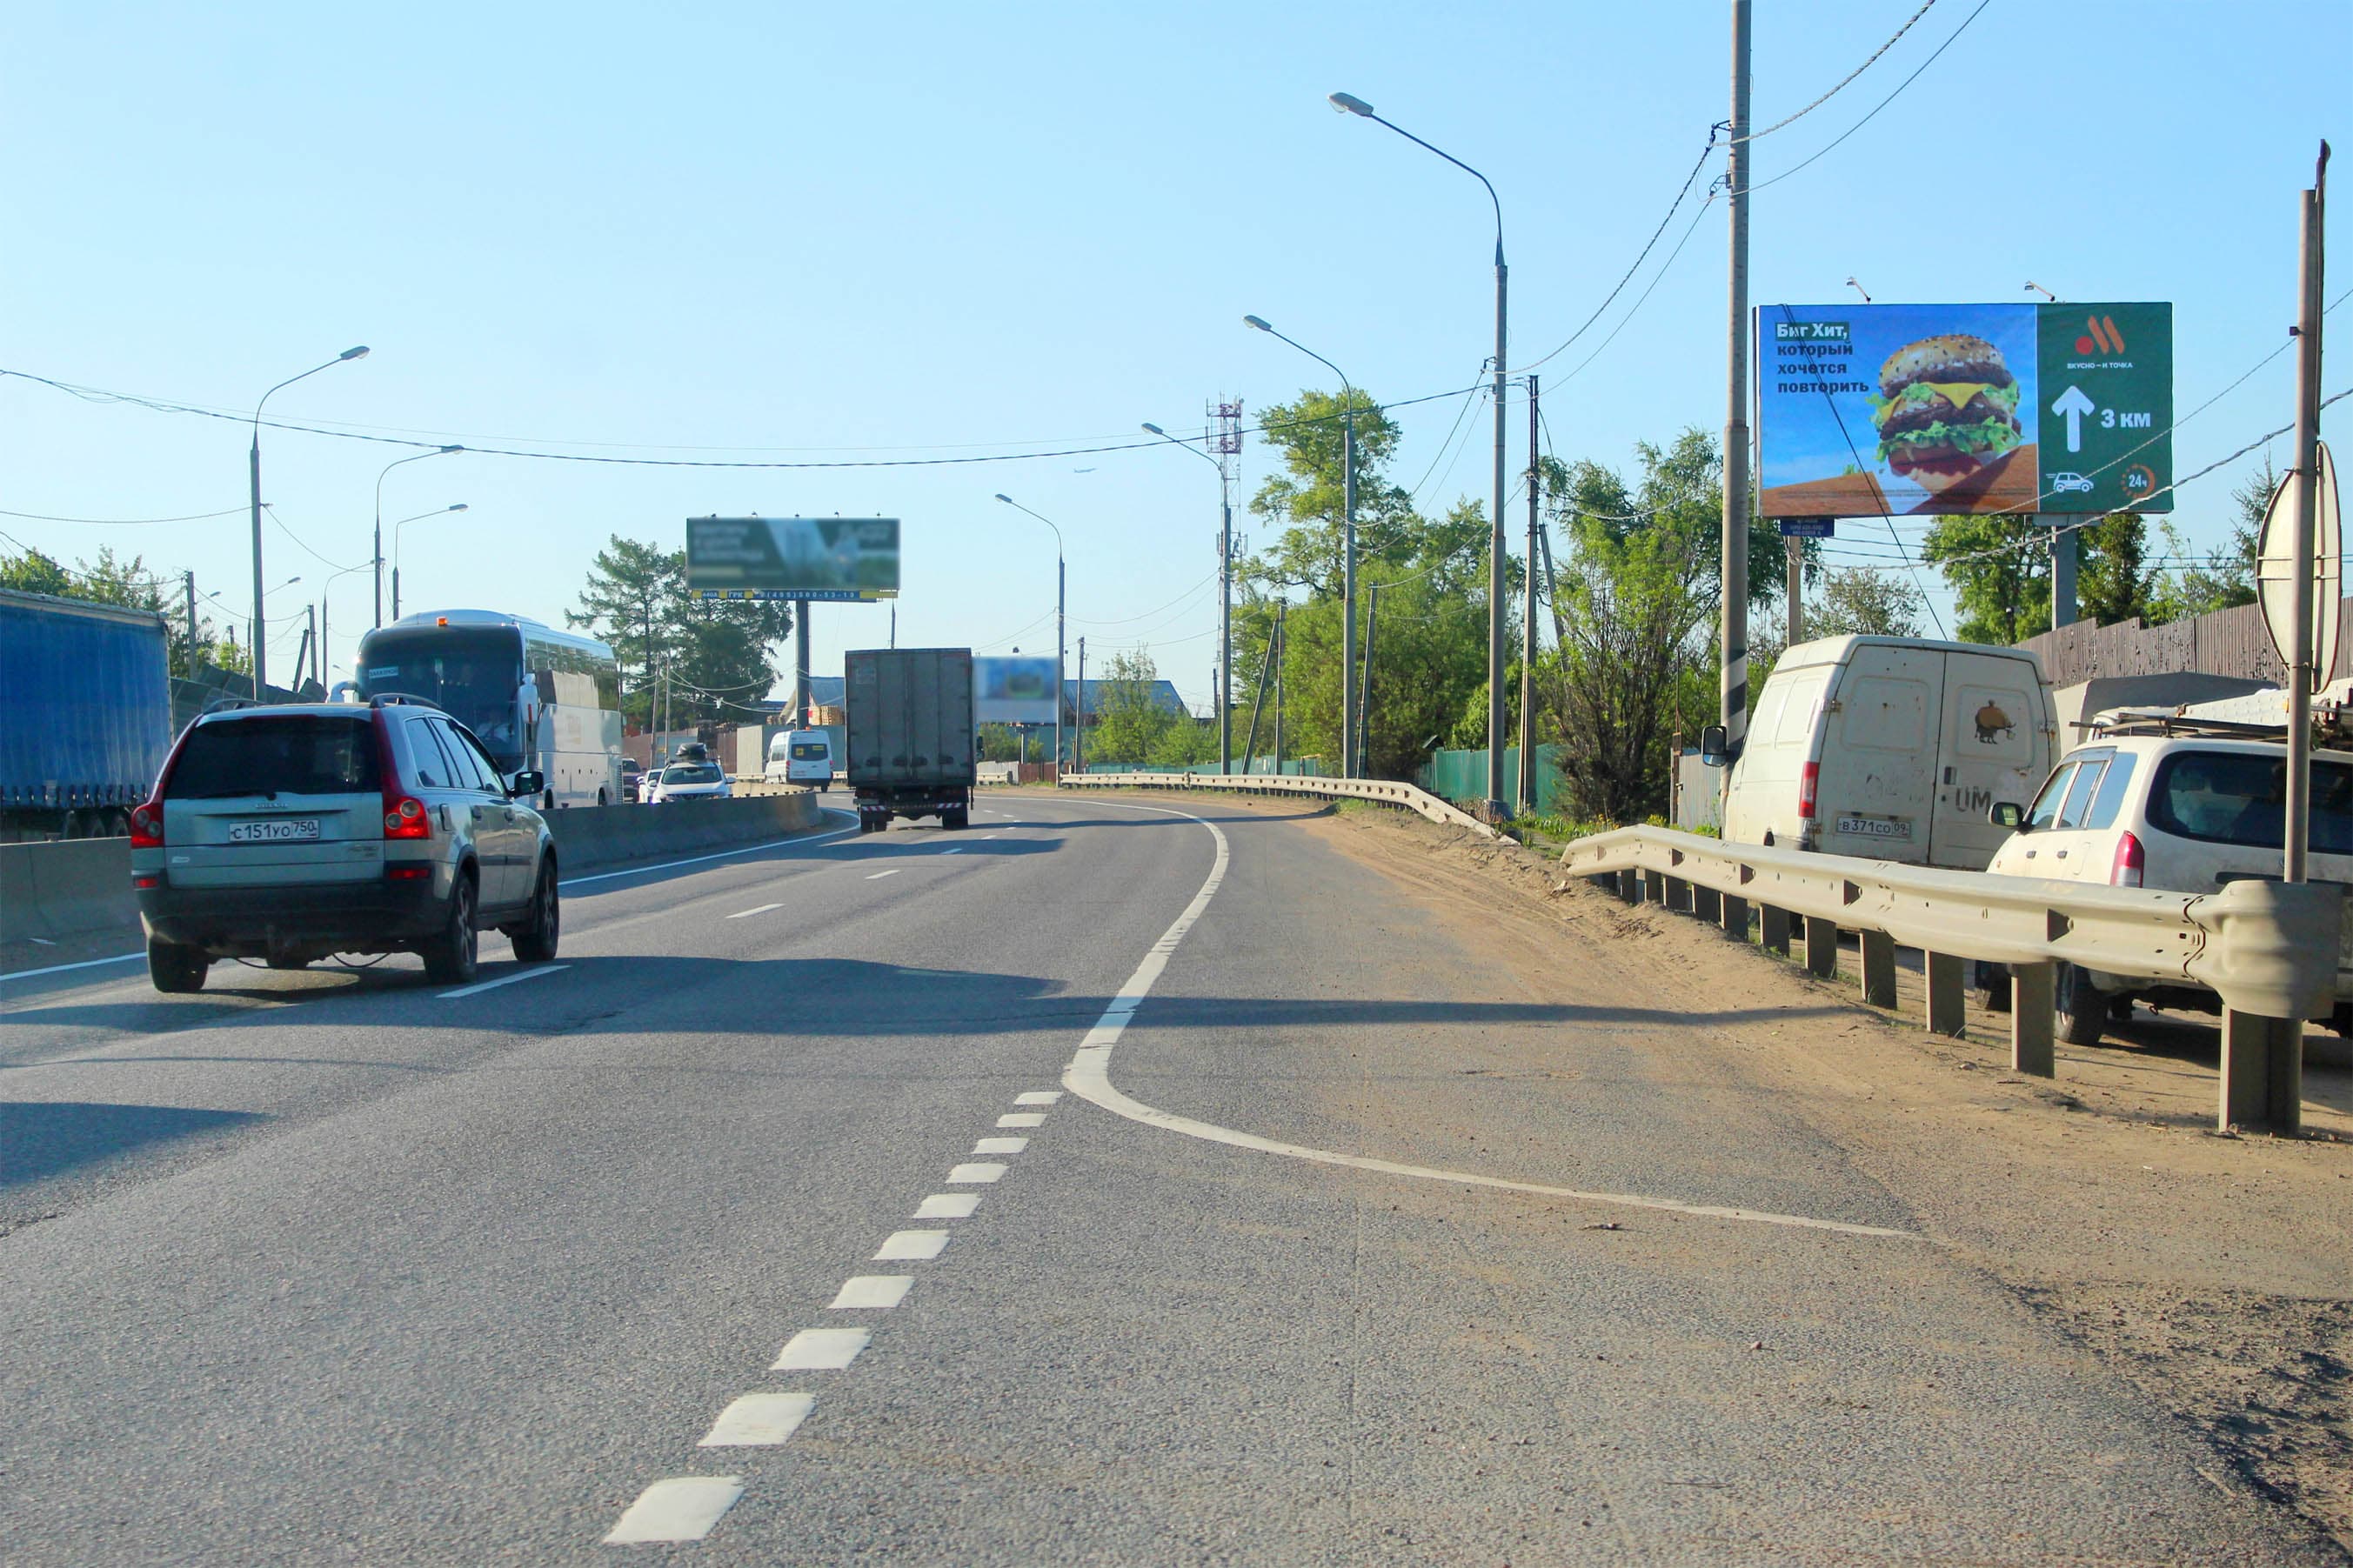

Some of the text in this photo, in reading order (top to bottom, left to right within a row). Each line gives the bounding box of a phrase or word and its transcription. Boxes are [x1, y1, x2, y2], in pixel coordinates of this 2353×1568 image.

[1777, 324, 1848, 339] Биг Хит,
[1777, 340, 1853, 357] который
[1777, 364, 1847, 375] хочется
[1778, 382, 1869, 395] повторить
[2101, 409, 2116, 428] 3
